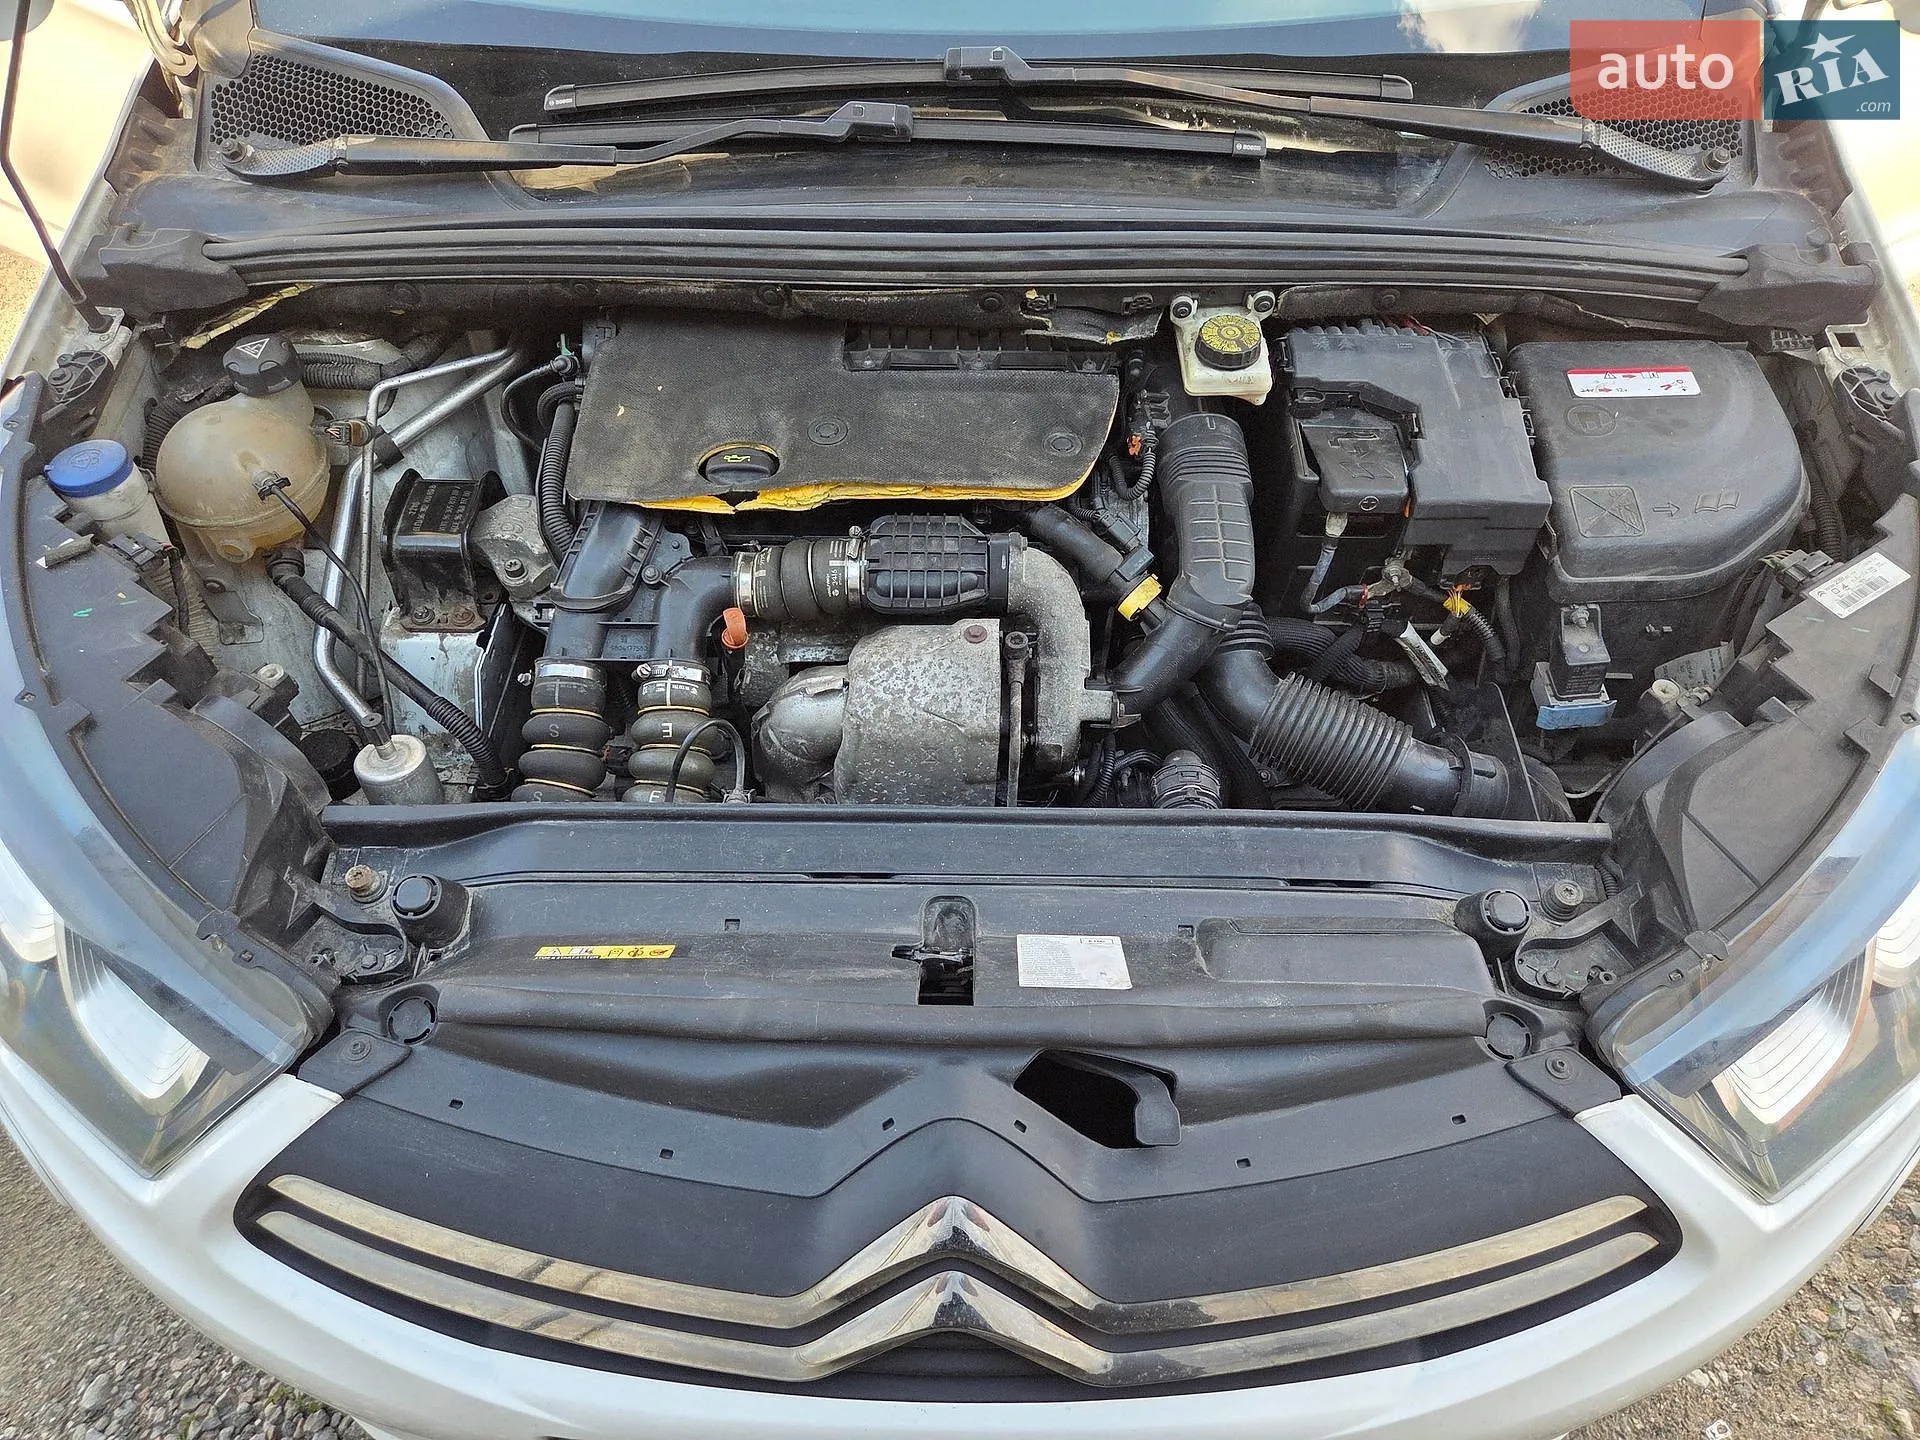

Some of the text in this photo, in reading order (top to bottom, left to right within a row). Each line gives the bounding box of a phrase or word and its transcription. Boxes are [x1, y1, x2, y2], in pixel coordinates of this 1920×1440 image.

[549, 724, 560, 738] S
[661, 722, 673, 738] E
[532, 791, 543, 802] S
